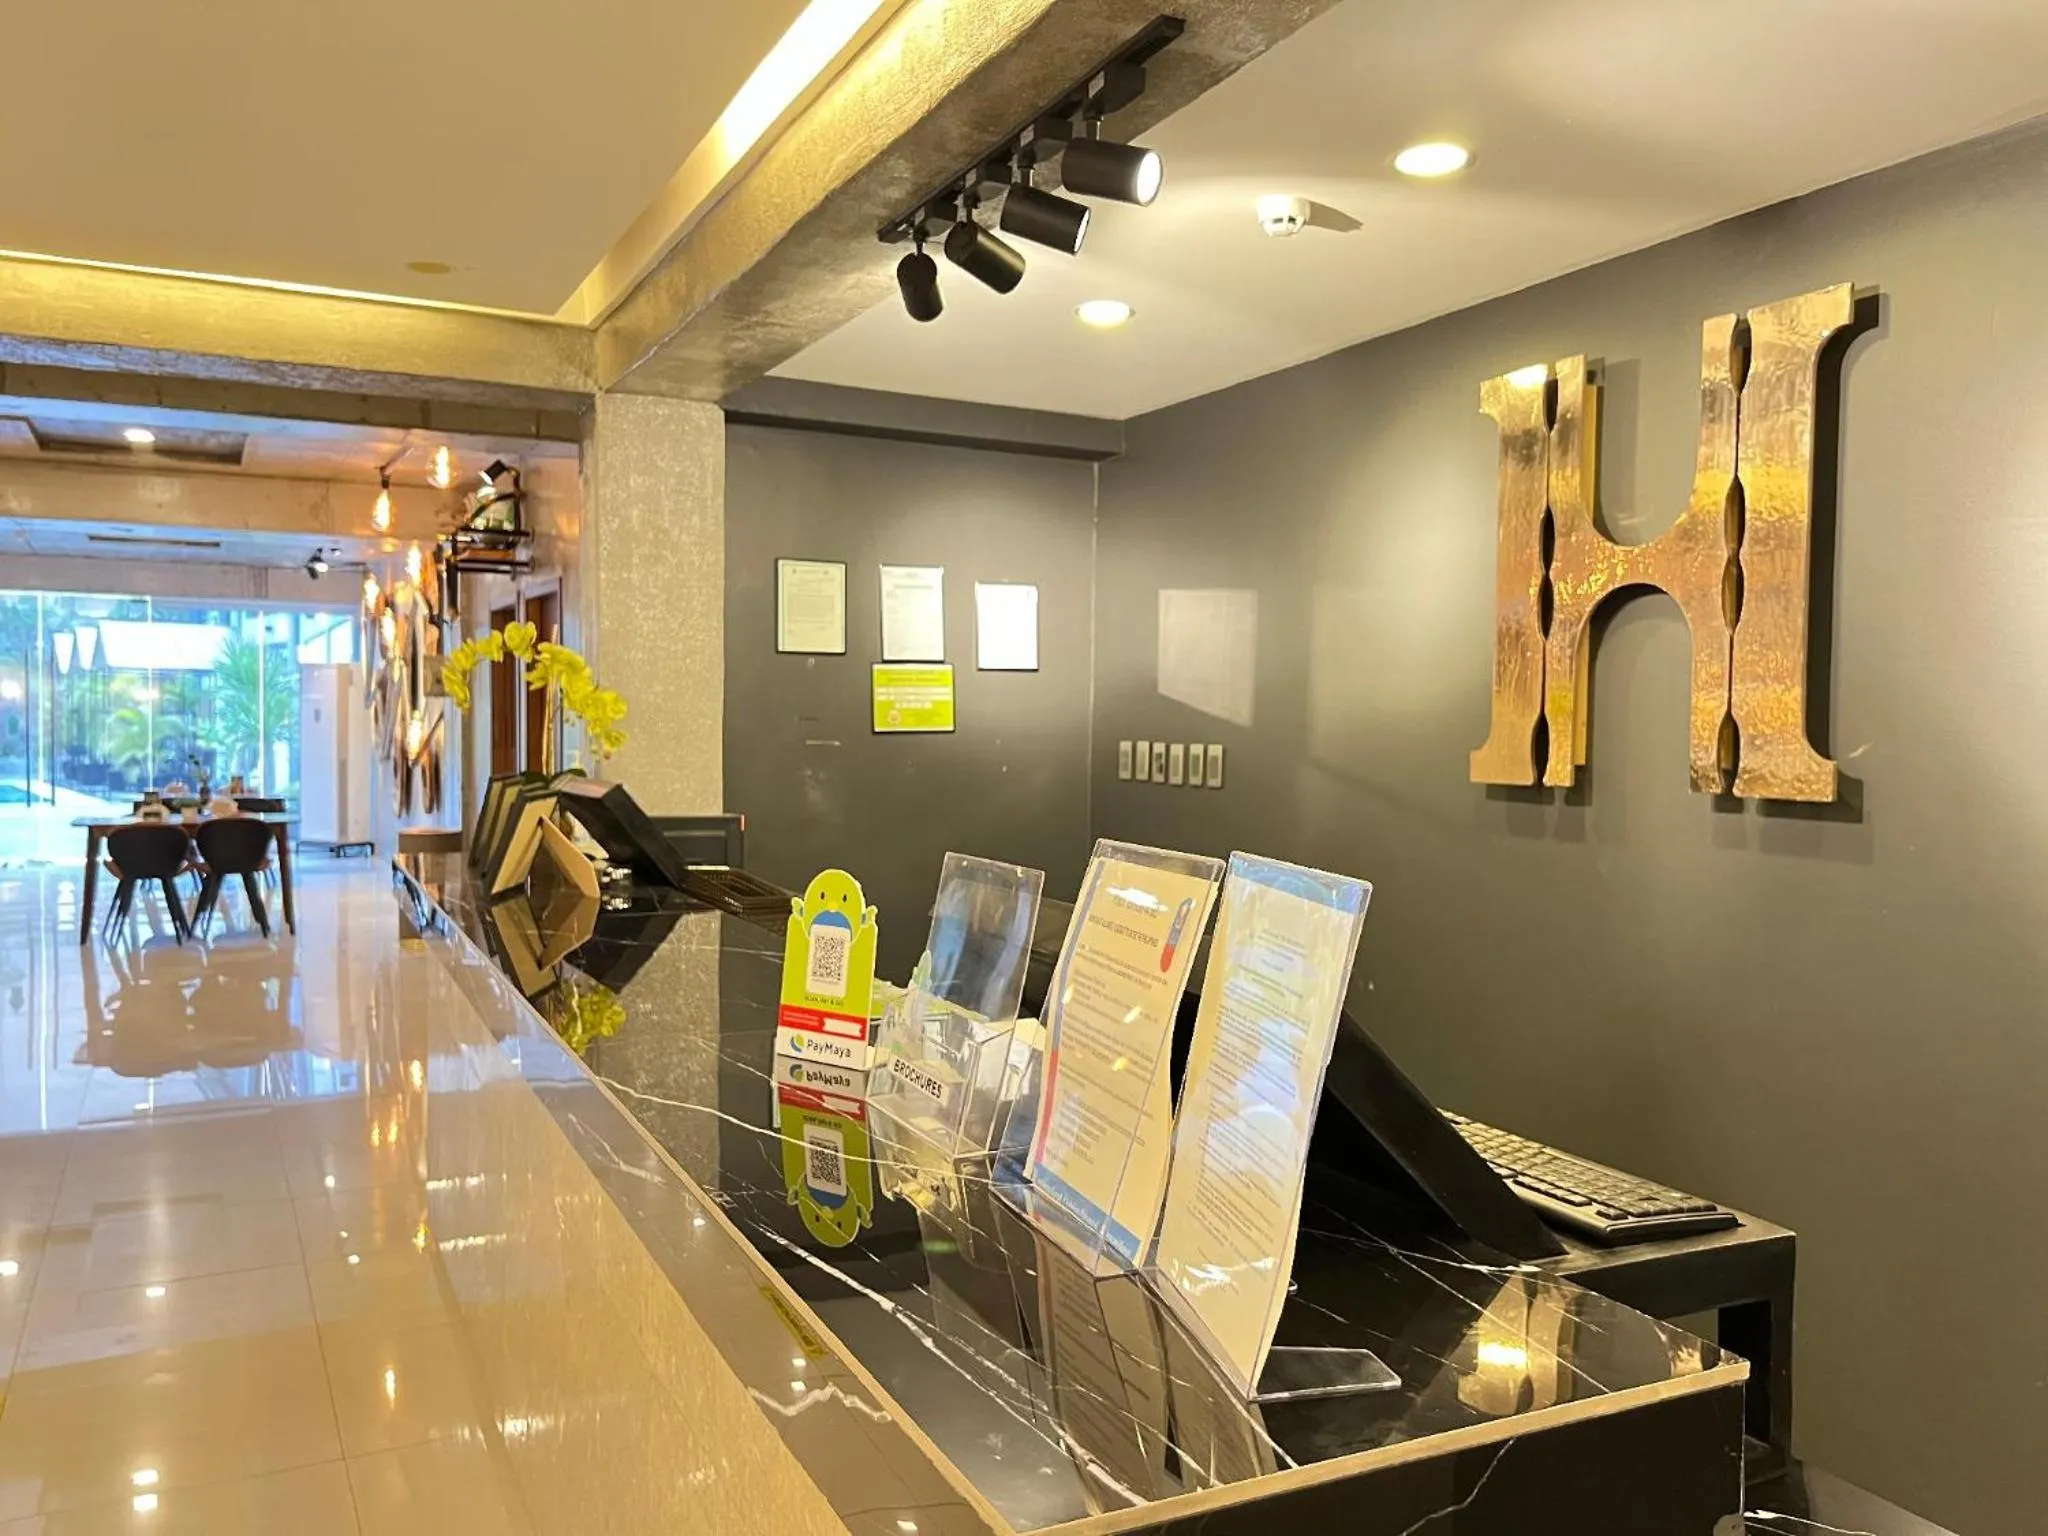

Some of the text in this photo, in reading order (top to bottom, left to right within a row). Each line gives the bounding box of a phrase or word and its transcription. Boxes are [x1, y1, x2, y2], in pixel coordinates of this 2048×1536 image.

[1470, 282, 1854, 803] H
[806, 1038, 851, 1058] PayMaya
[893, 1058, 943, 1099] BROCHURES
